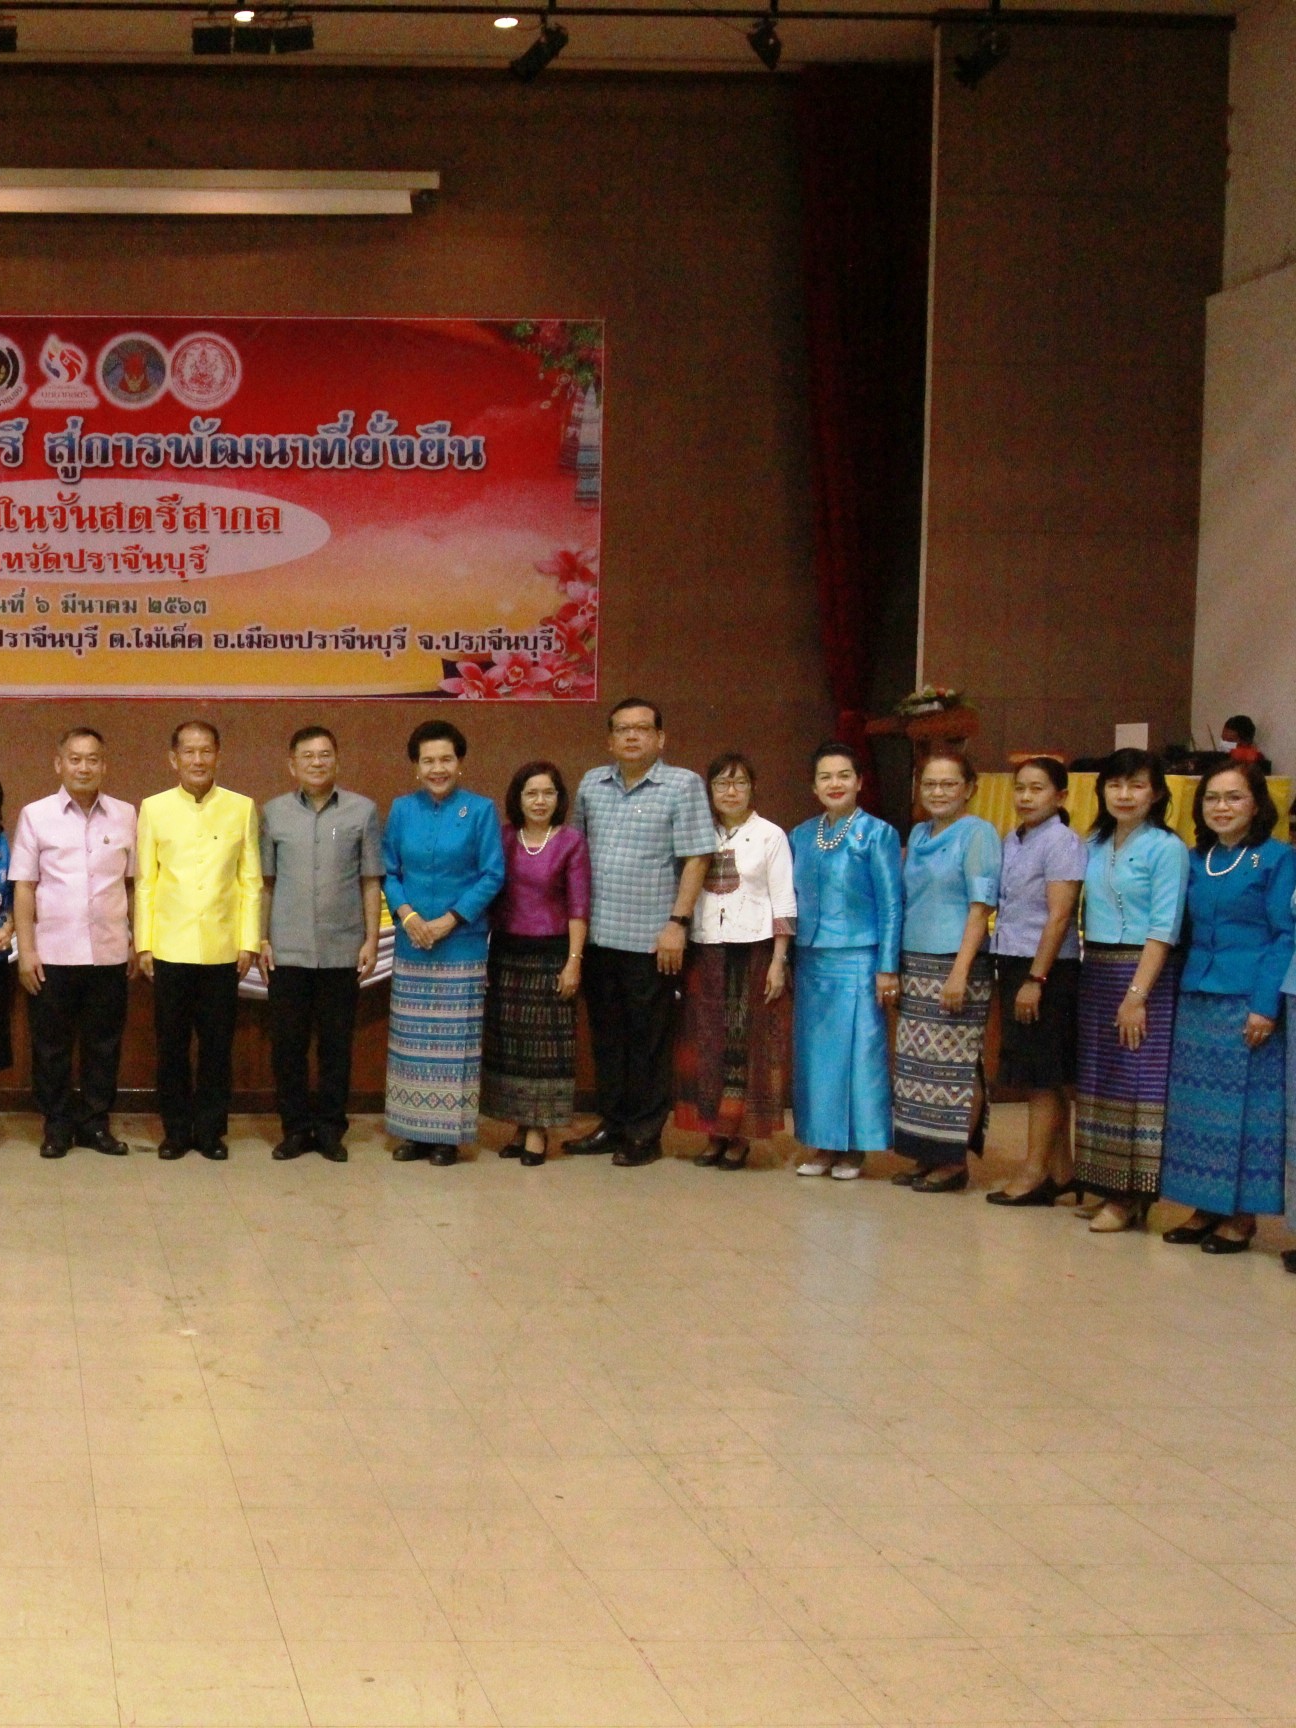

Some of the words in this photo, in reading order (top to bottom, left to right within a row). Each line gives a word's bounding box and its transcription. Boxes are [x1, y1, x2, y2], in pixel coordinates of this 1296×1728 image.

[45, 411, 485, 480] สู่การพัฒนาที่ยั่งยืน
[35, 597, 50, 614] ๖
[61, 593, 138, 614] มีนาคม
[148, 595, 207, 614] ๒๕๖๓
[109, 623, 203, 649] ต.ไม้เค็ด
[213, 625, 407, 657] อ.เมืองปราจีนบุรี
[418, 627, 553, 657] จ.ปราจีนบุรี
